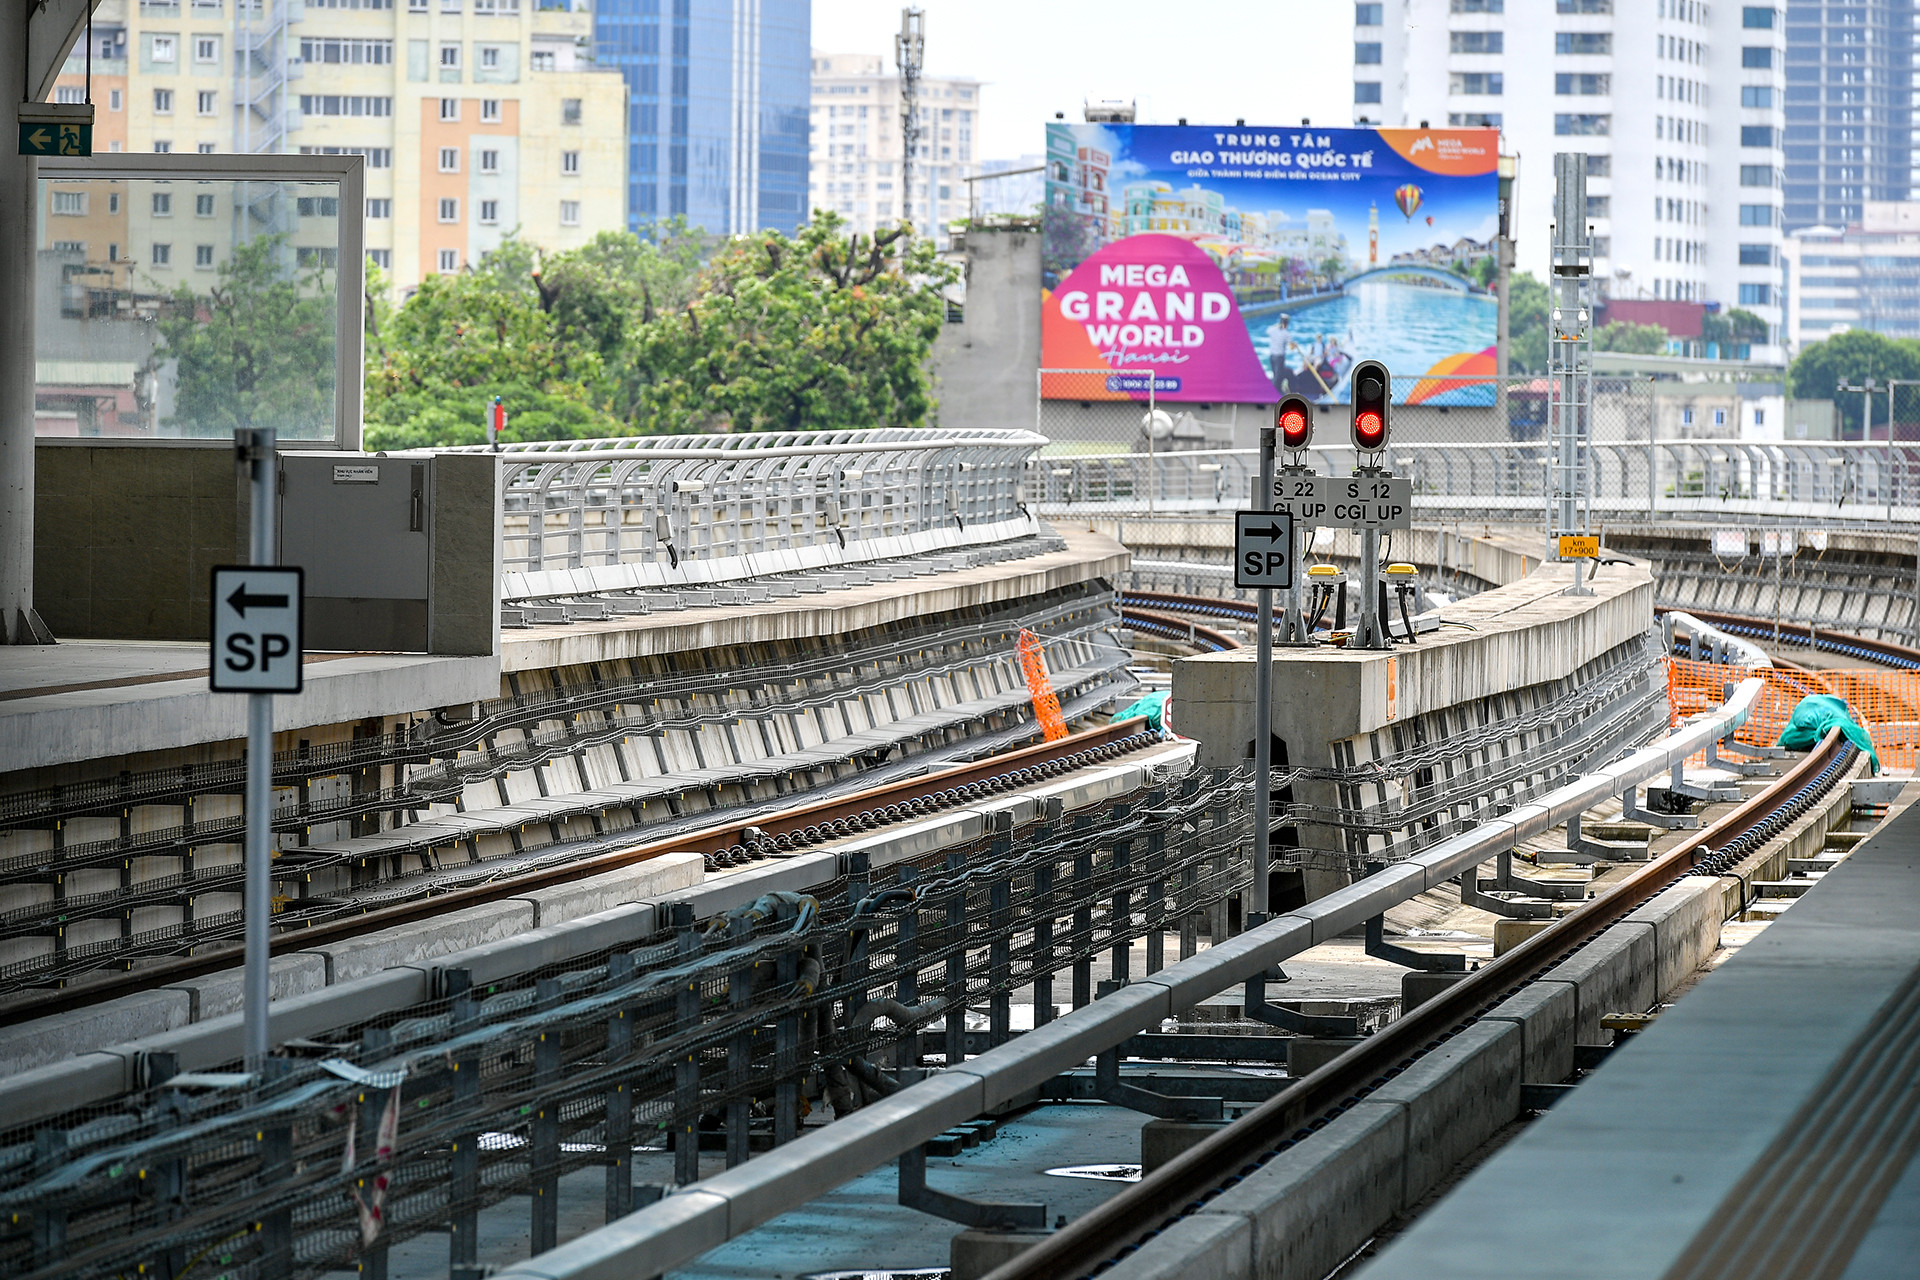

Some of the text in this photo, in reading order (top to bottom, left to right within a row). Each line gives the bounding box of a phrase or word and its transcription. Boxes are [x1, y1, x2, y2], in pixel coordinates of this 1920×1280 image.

[1213, 132, 1331, 148] TRUNG TÂM
[1437, 138, 1463, 147] MEGA
[1170, 148, 1374, 169] GIAO THƯƠNG QUỐC TẾ
[1340, 171, 1361, 181] CITY
[1100, 264, 1191, 287] MEGA
[1059, 290, 1231, 322] GRAND
[1085, 324, 1205, 348] WORLD
[1098, 343, 1190, 367] Hanoi
[1273, 482, 1315, 500] S_22
[1347, 483, 1390, 502] S_12
[1334, 504, 1403, 524] CGI_UP
[1243, 551, 1285, 576] SP
[224, 632, 290, 672] SP
